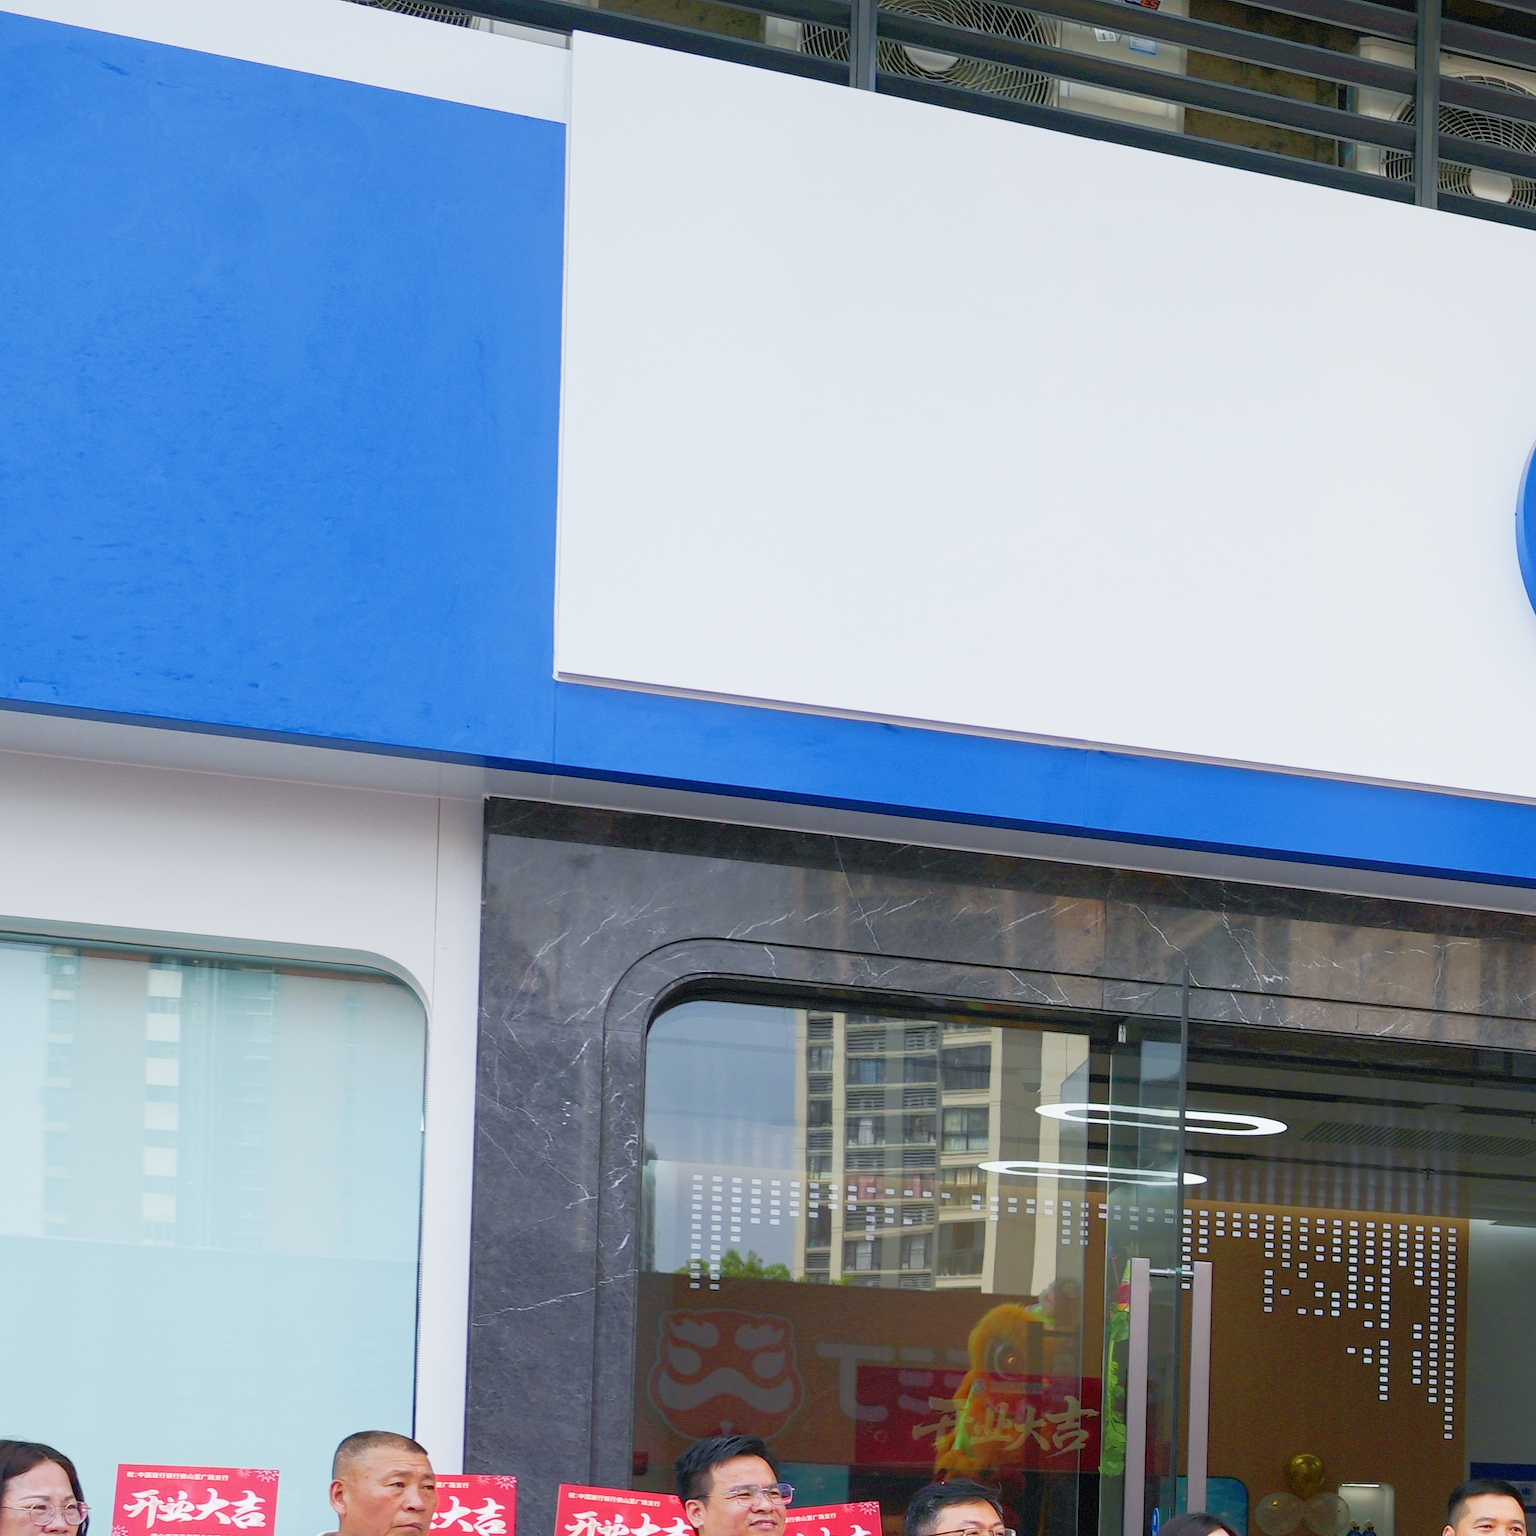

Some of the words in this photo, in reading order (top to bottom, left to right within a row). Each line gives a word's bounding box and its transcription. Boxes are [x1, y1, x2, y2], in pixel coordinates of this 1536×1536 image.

[123, 1488, 266, 1529] 开业大吉
[430, 1495, 507, 1536] 大吉
